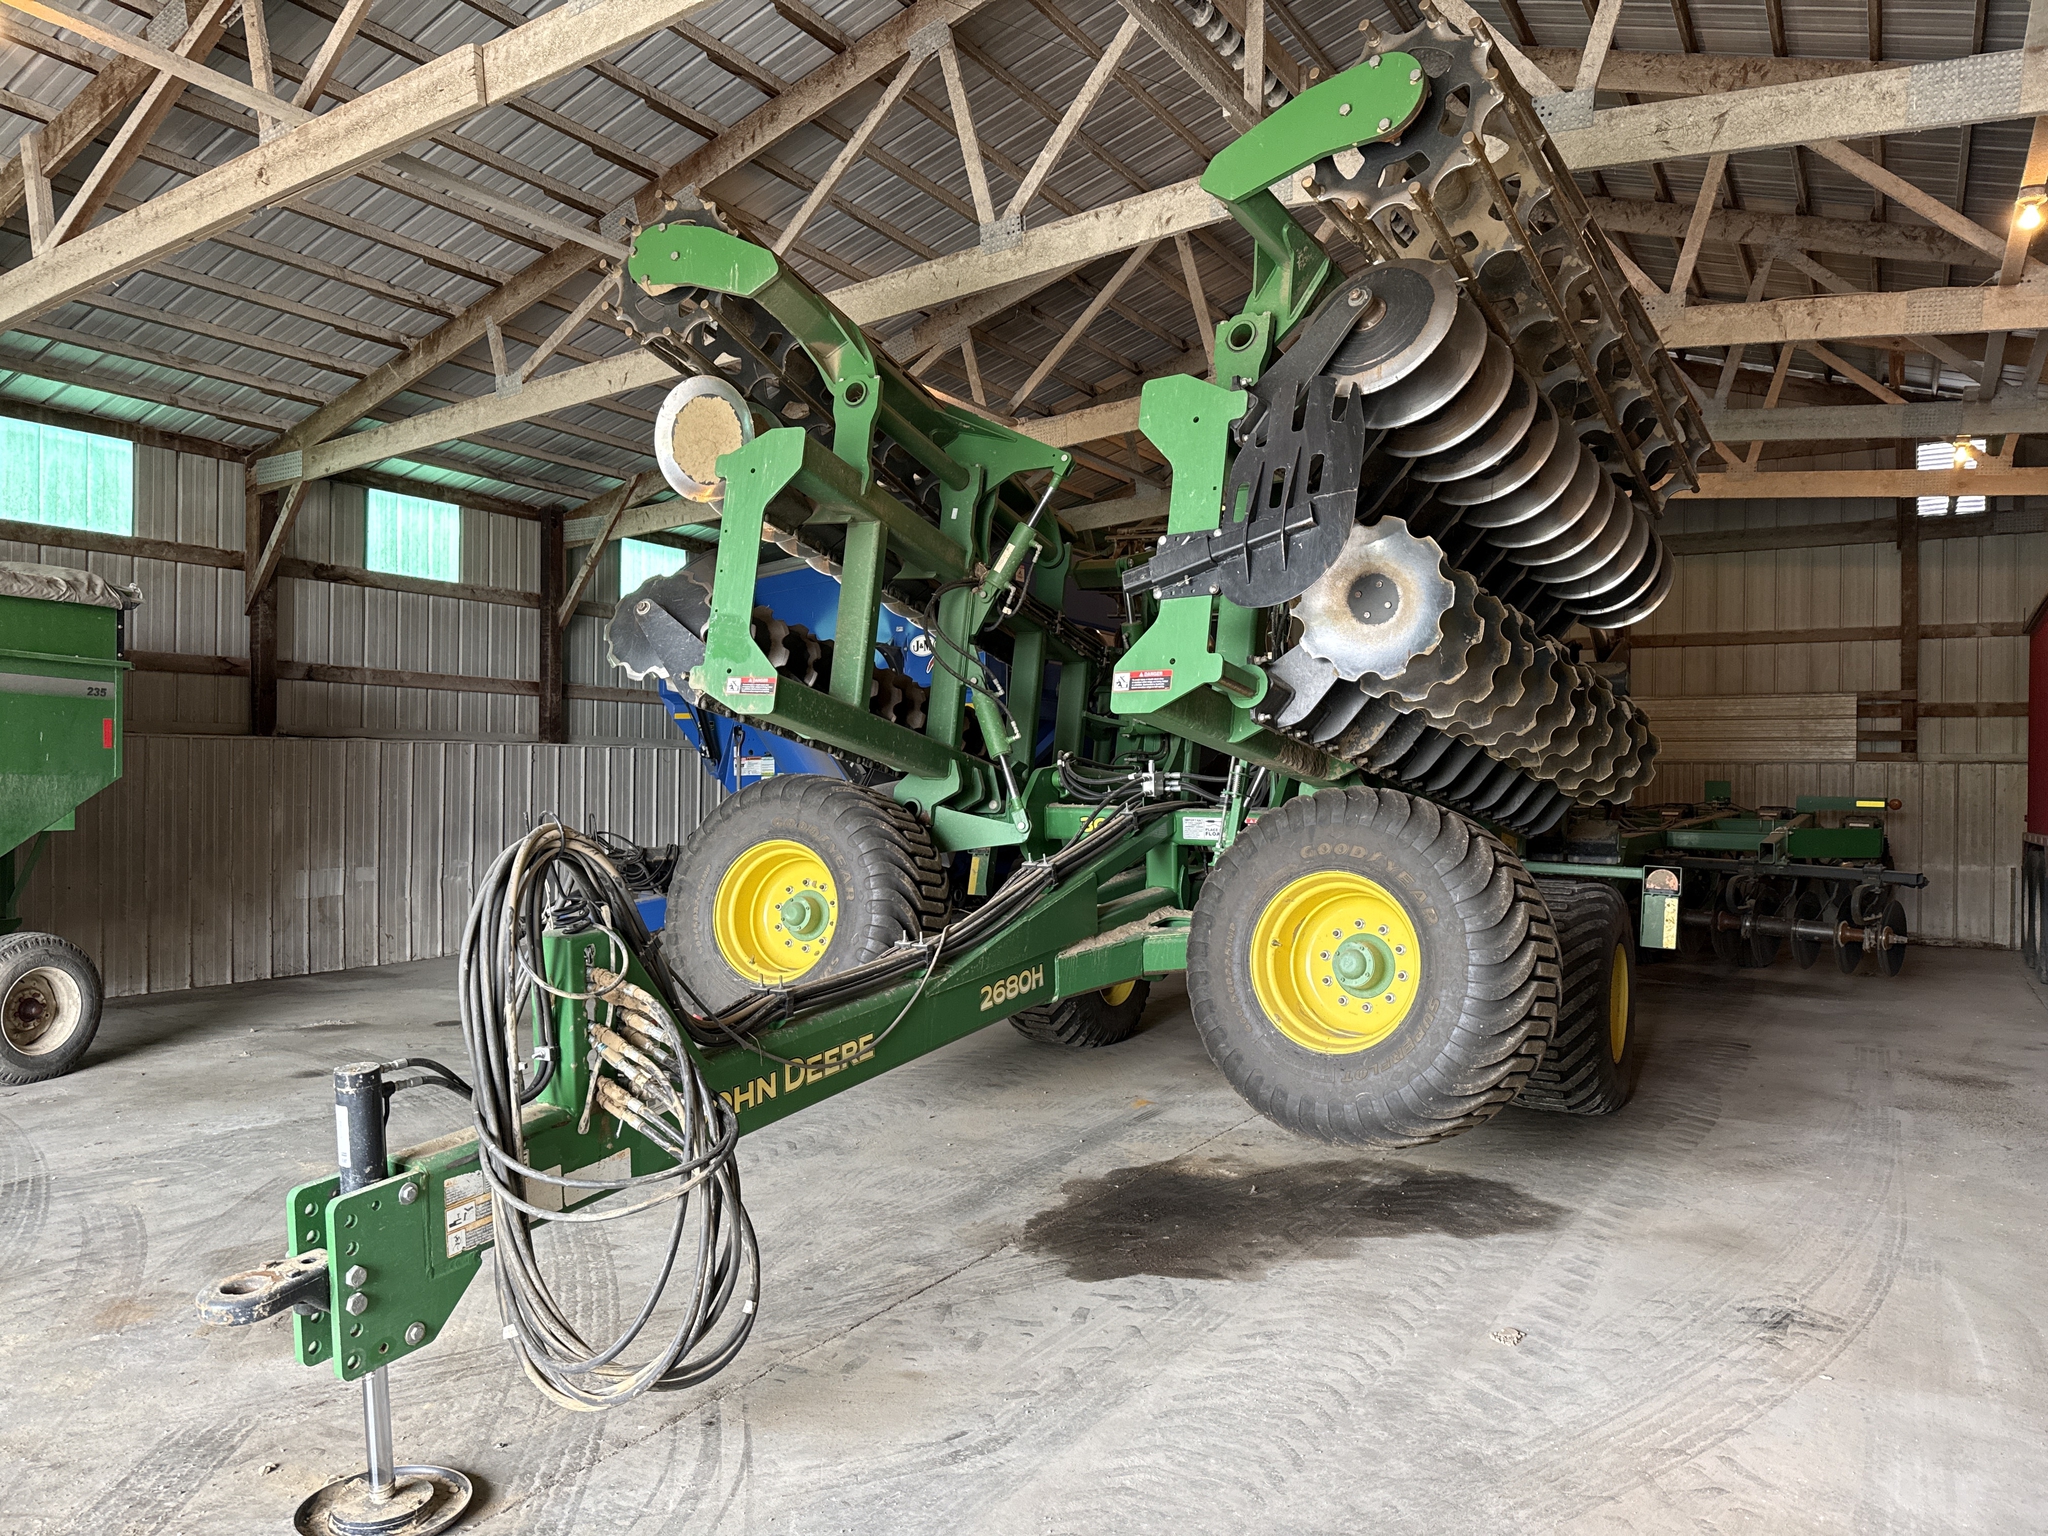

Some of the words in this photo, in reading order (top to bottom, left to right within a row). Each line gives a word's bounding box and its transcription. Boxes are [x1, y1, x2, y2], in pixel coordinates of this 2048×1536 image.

[87, 686, 107, 697] 235
[1300, 842, 1439, 925] GOODYEAR
[980, 963, 1044, 1012] 2680H
[784, 1033, 875, 1094] DEERE
[1340, 997, 1440, 1082] SUPERFLOT
